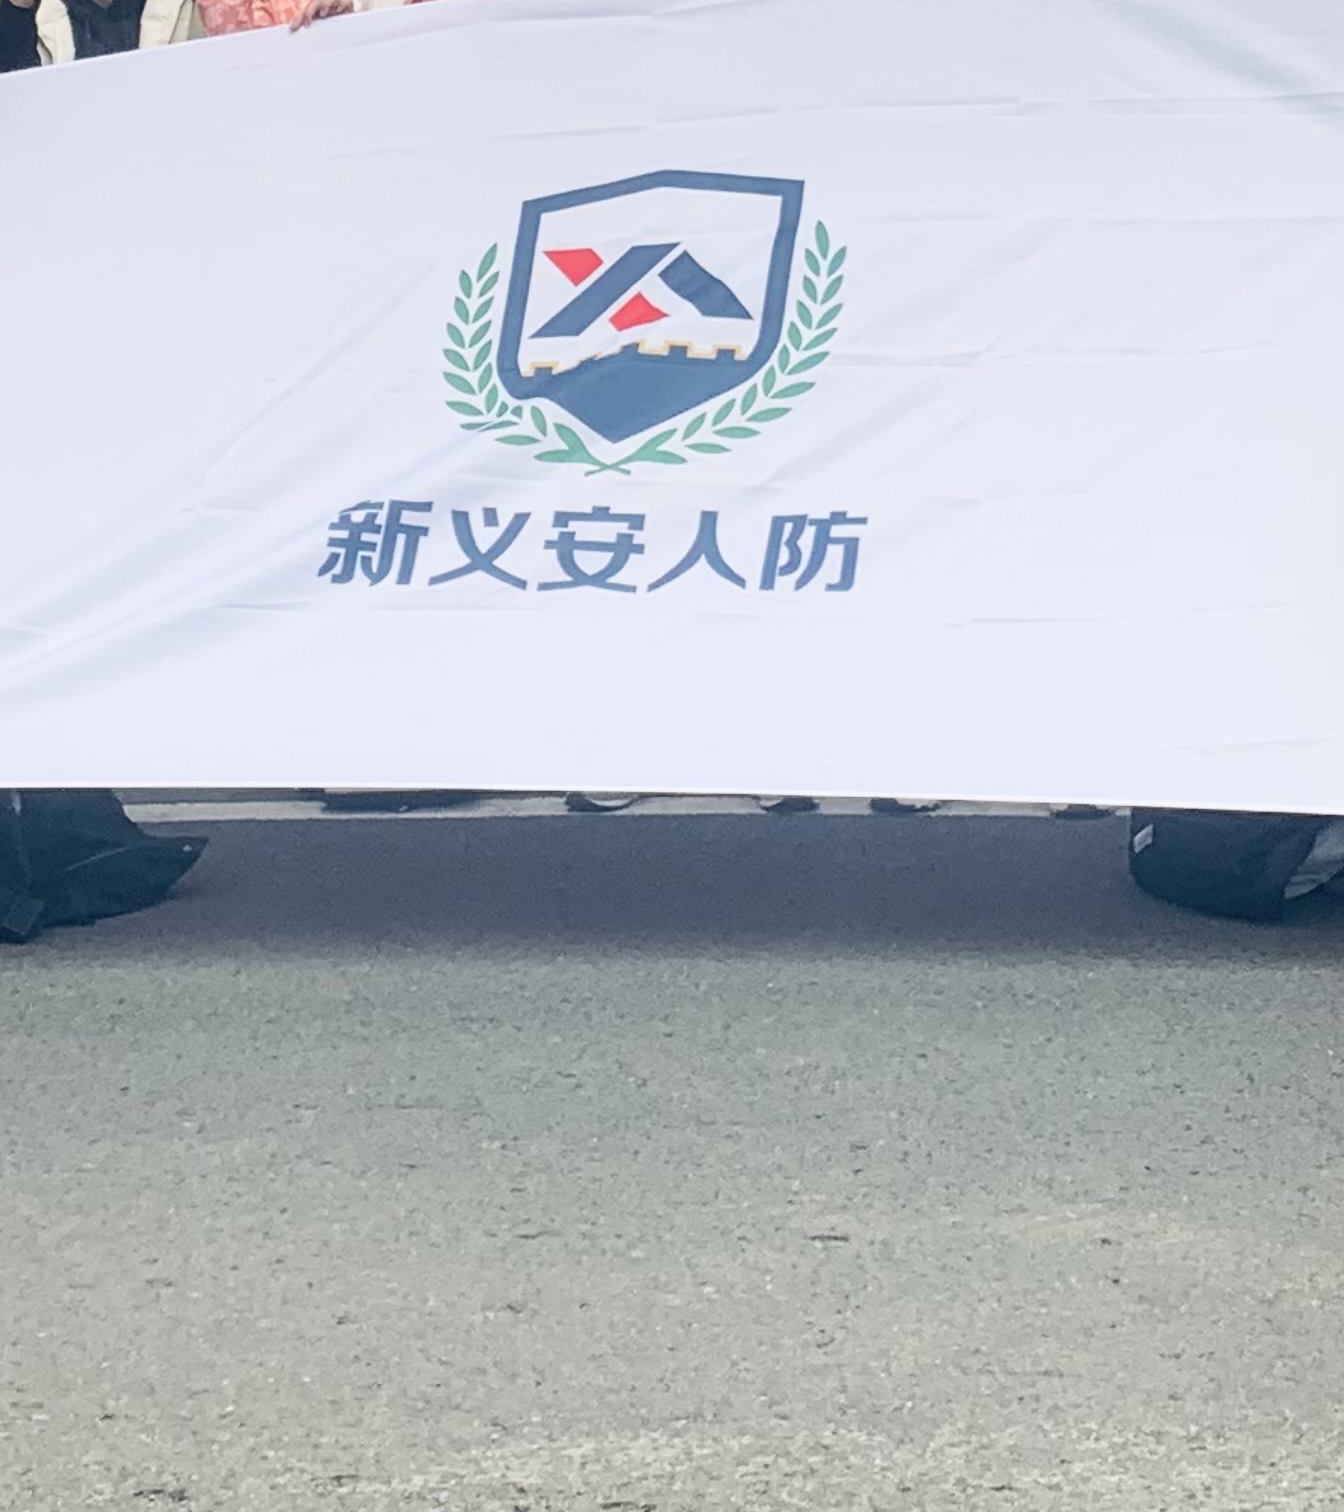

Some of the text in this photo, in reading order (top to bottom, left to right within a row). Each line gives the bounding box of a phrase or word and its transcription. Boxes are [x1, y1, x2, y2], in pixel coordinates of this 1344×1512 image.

[317, 499, 868, 593] 新义安人防
